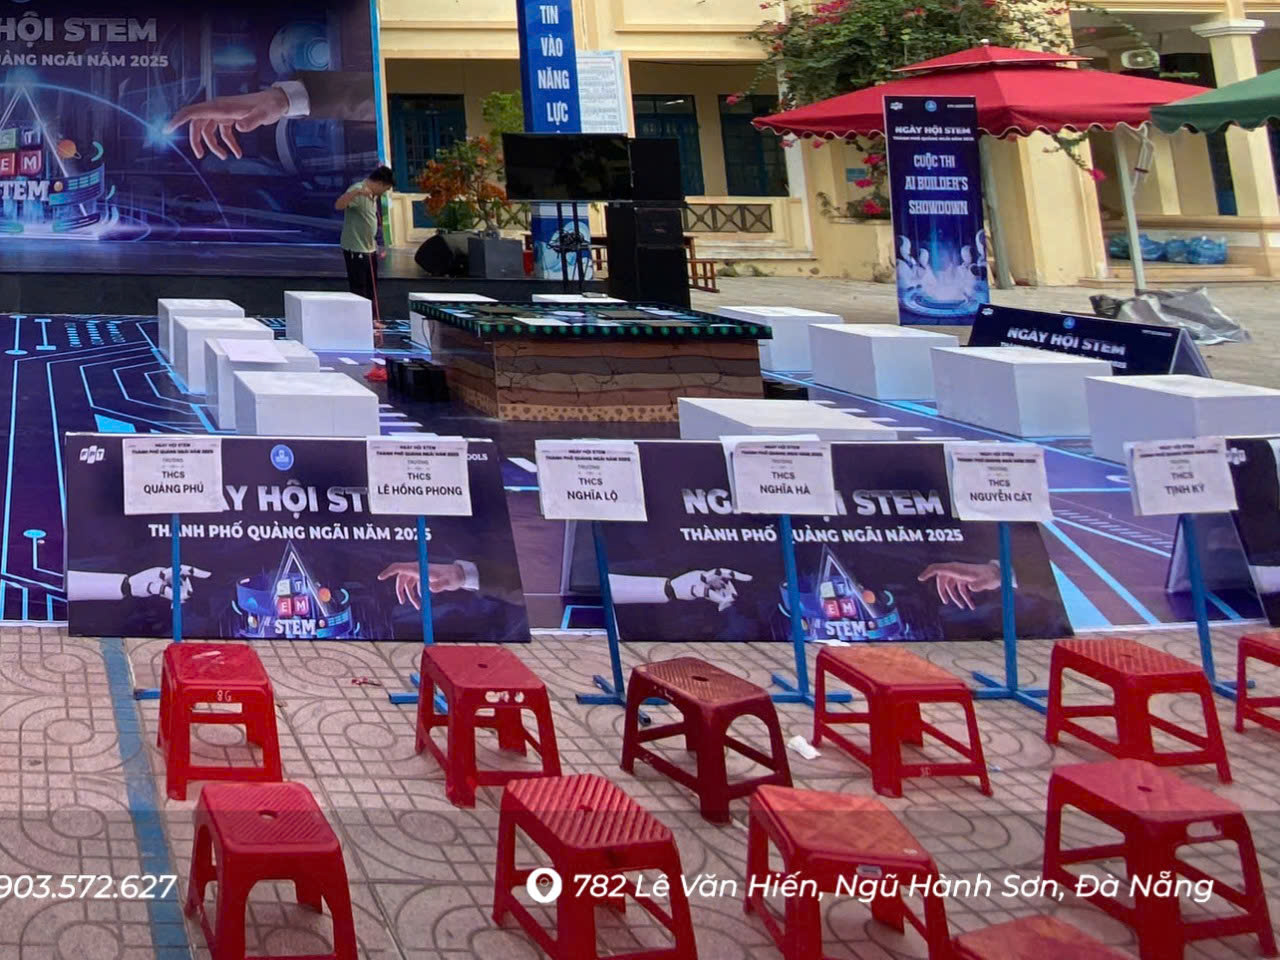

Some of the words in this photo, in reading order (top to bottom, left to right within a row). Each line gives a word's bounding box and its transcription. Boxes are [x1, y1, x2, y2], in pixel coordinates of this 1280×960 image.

[540, 5, 559, 24] TIN
[65, 18, 157, 42] STEM
[541, 34, 563, 56] VÀO
[42, 52, 82, 67] NGÃI
[88, 52, 125, 67] NĂM
[130, 55, 169, 68] 2025
[538, 68, 569, 89] NĂNG
[547, 102, 568, 125] LỰC
[914, 152, 938, 170] CUỘC
[940, 155, 955, 168] THI
[905, 176, 915, 190] AI
[917, 176, 968, 191] BUILDER'S
[909, 200, 968, 215] SHOWDOWN
[1007, 327, 1048, 343] NGÀY
[1051, 331, 1078, 348] HỘI
[162, 471, 185, 479] THCS
[578, 477, 603, 486] THCS
[771, 472, 795, 480] THCS
[989, 479, 1010, 488] THCS
[378, 484, 390, 495] LÊ
[426, 486, 463, 496] PHONG
[567, 489, 603, 501] NGHĨA
[604, 490, 618, 502] LỘ
[760, 483, 793, 494] NGHĨA
[795, 483, 811, 495] HÀ
[259, 479, 318, 519] HỘI
[853, 489, 944, 515] STEM
[209, 521, 243, 538] PHỐ
[247, 521, 305, 541] QUẢNG
[310, 522, 349, 540] NGÃI
[354, 522, 390, 540] NĂM
[680, 525, 738, 541] THÀNH
[742, 523, 777, 541] PHỐ
[791, 525, 838, 544] UẢNG
[842, 526, 882, 542] NGÃI
[886, 525, 923, 542] NĂM
[926, 529, 964, 542] 2025
[275, 619, 316, 635] STEM
[825, 621, 867, 638] STEM
